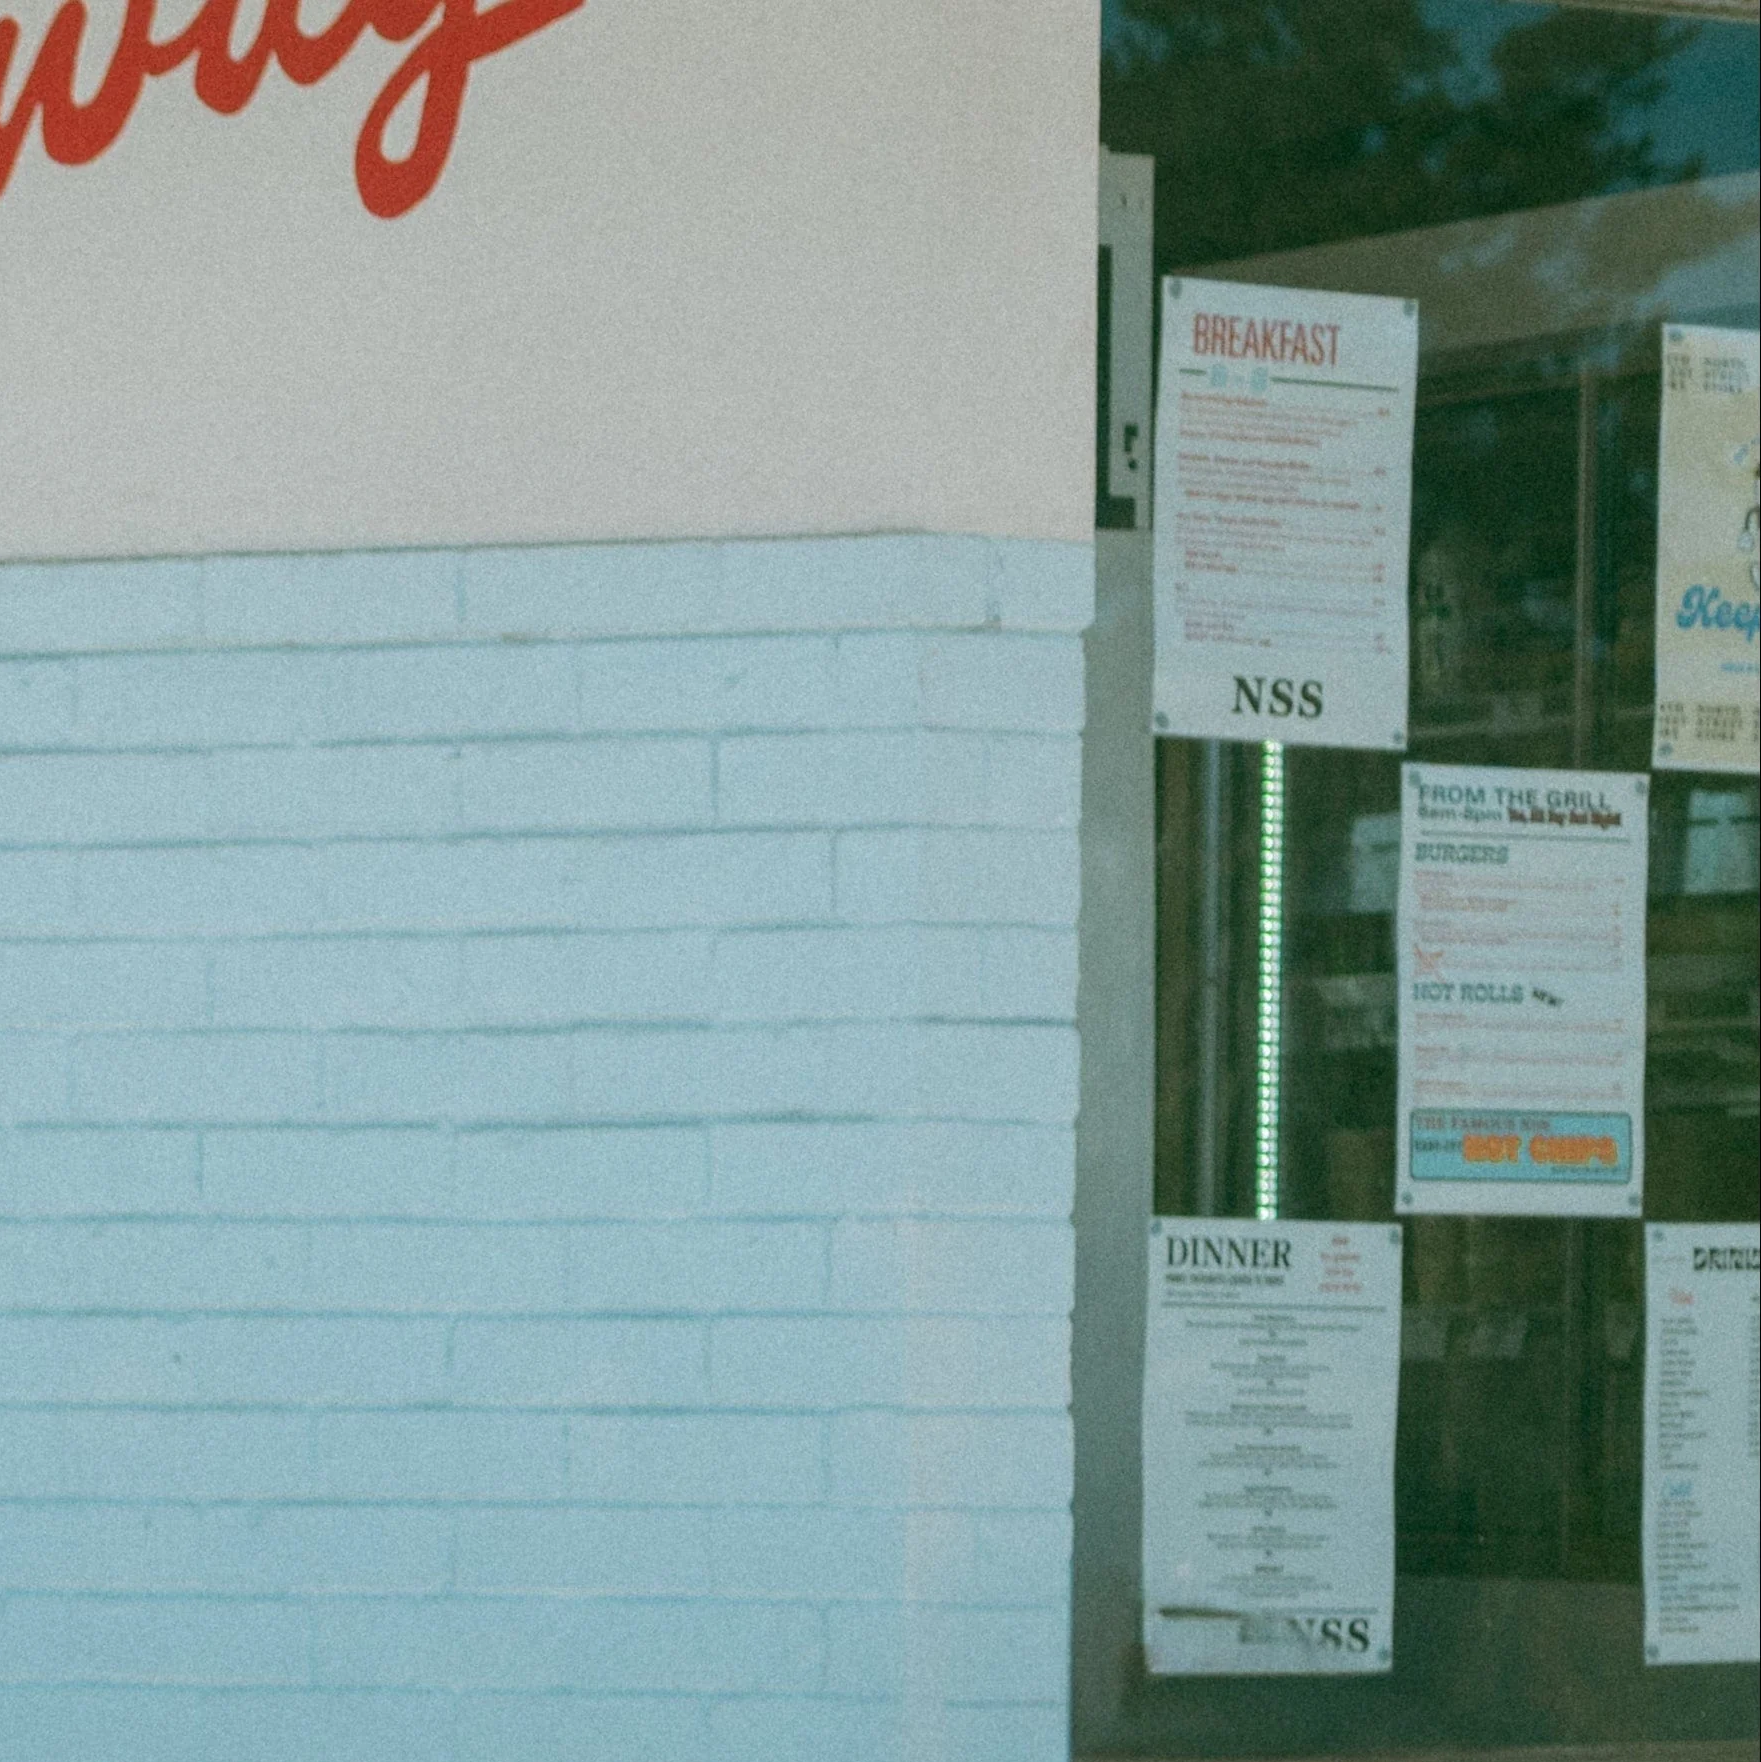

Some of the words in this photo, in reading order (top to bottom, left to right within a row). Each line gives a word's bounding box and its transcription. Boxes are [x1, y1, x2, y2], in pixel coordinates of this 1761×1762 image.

[1193, 311, 1342, 367] BREAKFAST
[1232, 675, 1324, 719] NSS
[1418, 784, 1486, 804] FROM
[1494, 786, 1538, 808] THE
[1546, 789, 1611, 813] GRILL
[1413, 983, 1455, 1002] HOT
[1460, 983, 1524, 1004] ROLLS
[1165, 1236, 1292, 1269] DINNER
